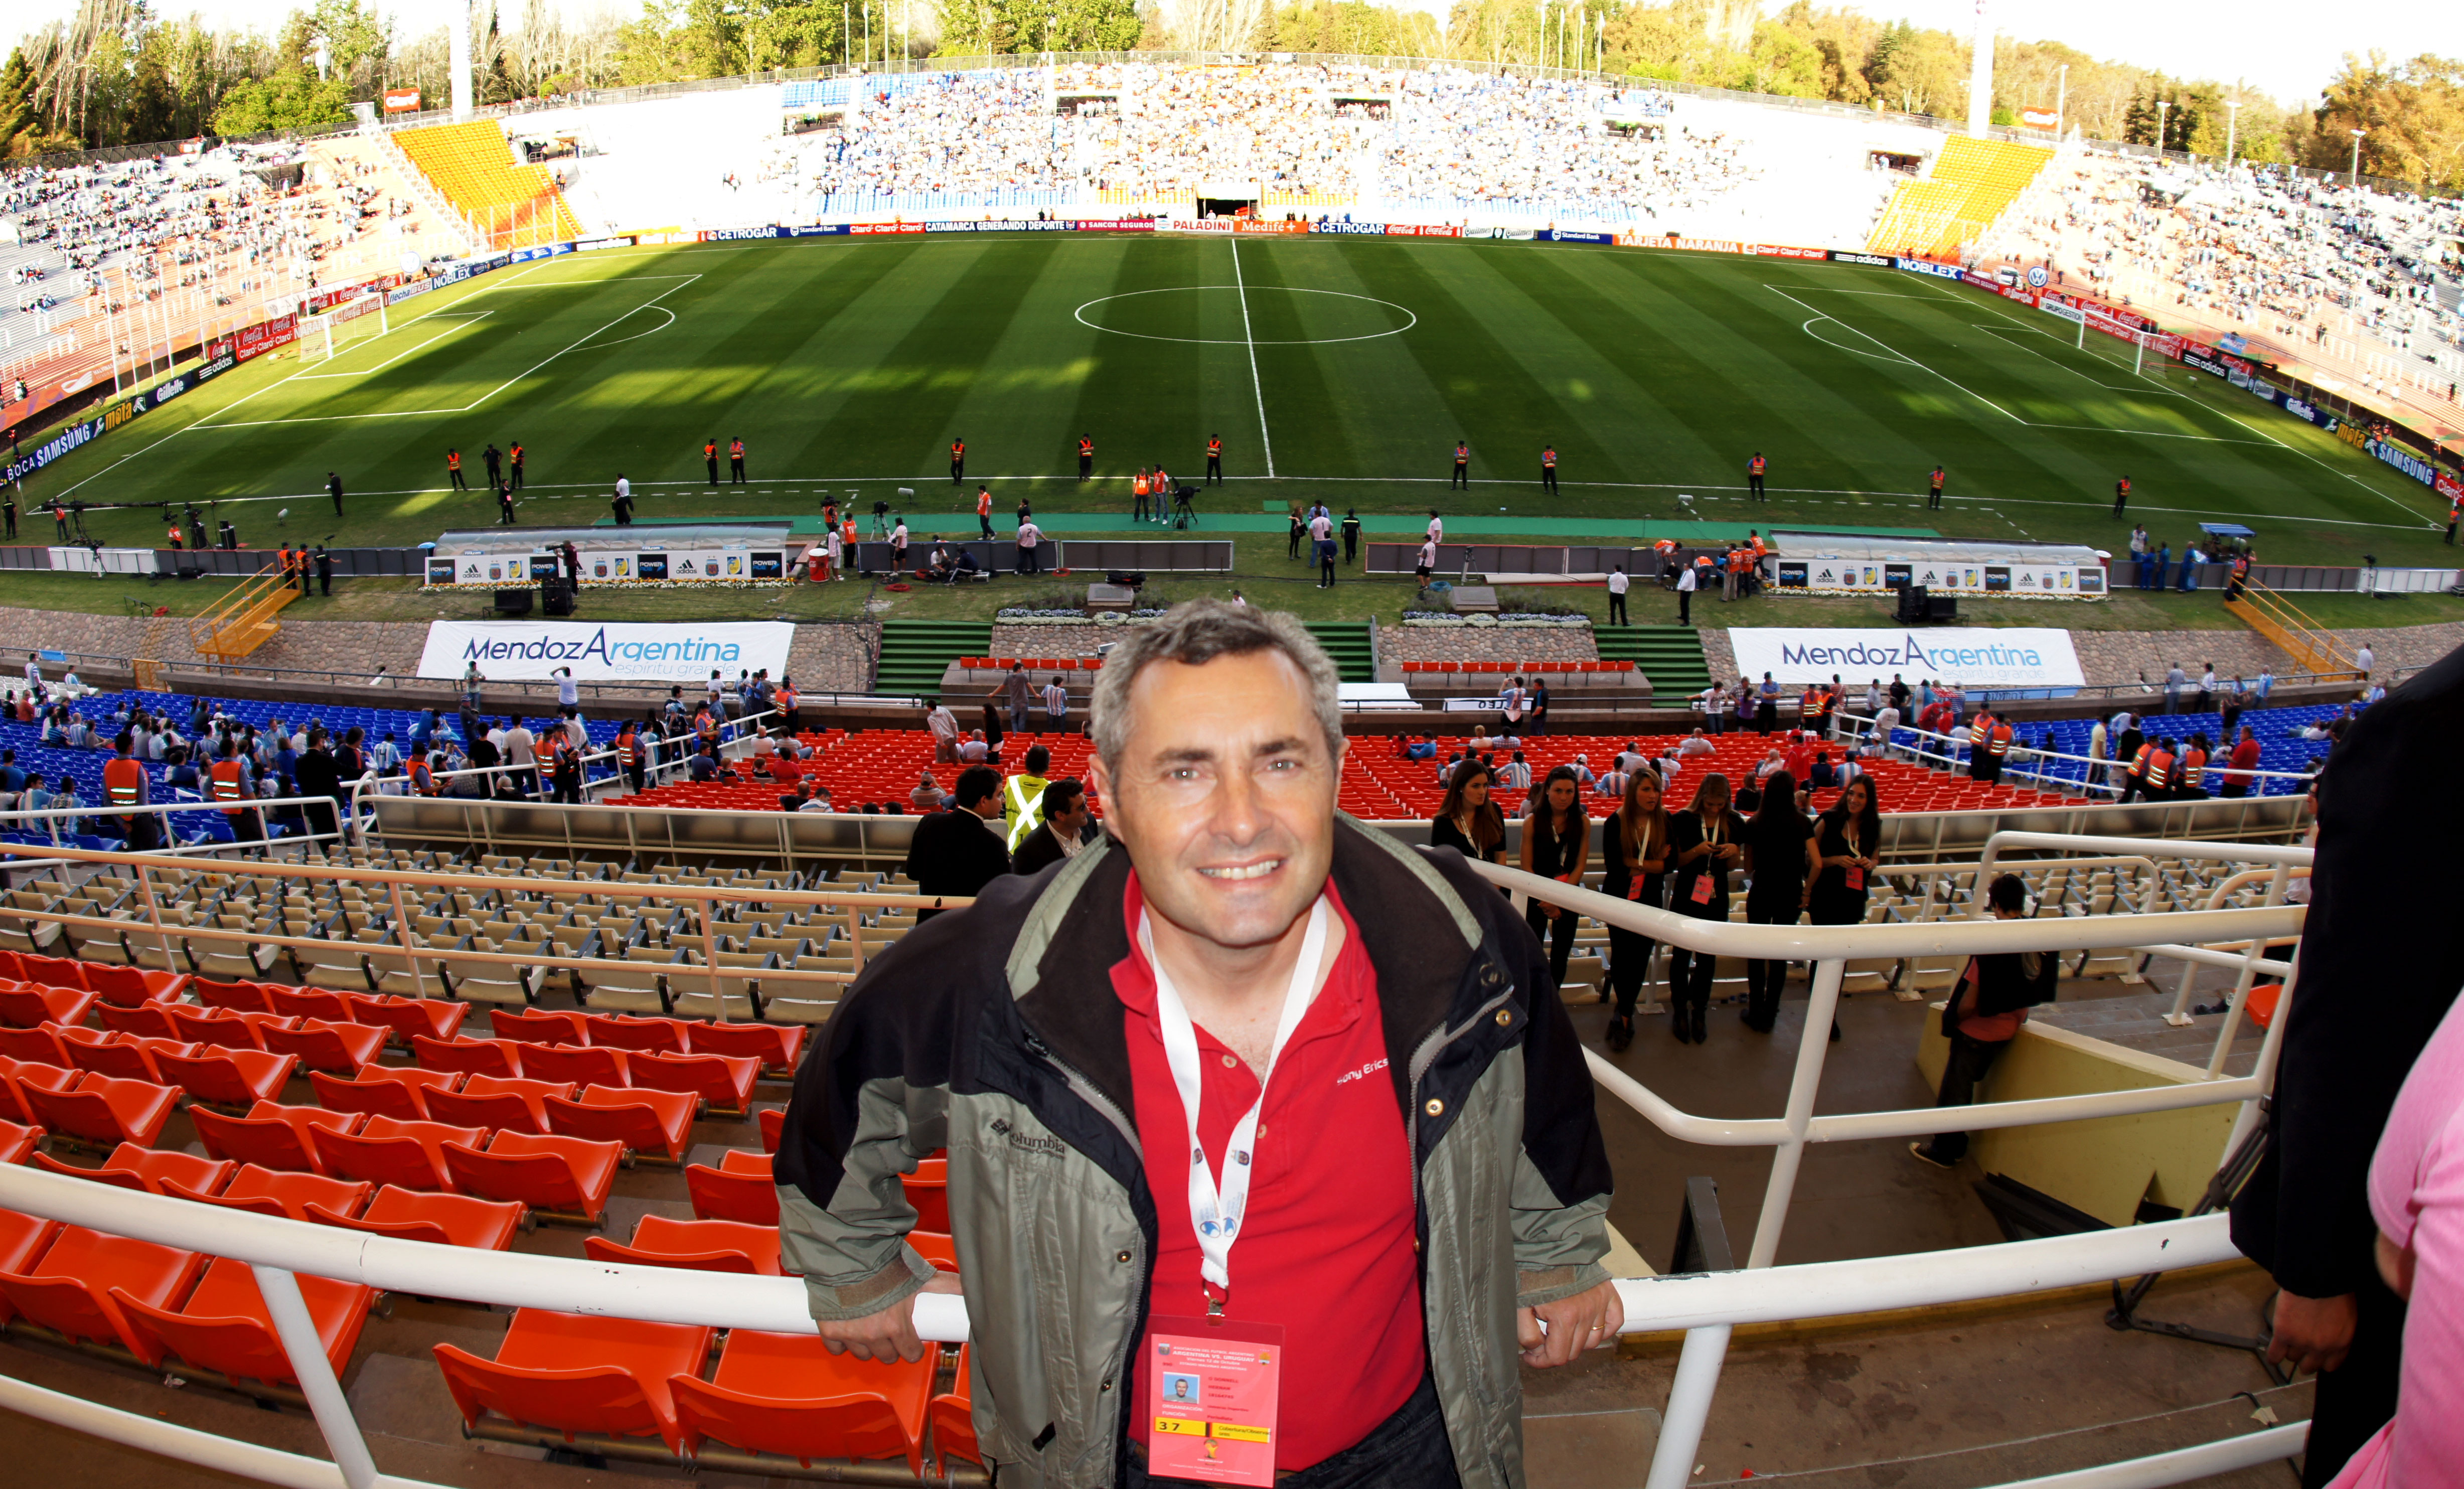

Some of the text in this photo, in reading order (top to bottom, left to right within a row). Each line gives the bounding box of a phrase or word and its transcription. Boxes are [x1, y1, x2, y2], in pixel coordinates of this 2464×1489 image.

[718, 227, 777, 240] CETROGAR
[850, 223, 923, 233] Claro Claro Claro
[926, 221, 1065, 232] CATAMARCA GENERANDO DEPORTE
[1173, 220, 1230, 230] PALADINI
[1242, 221, 1284, 231] Medifé
[1321, 223, 1385, 234] CETROGAR
[1388, 224, 1416, 234] Coca-Cola
[1425, 225, 1453, 235] Coca-Cola
[1465, 226, 1491, 235] Quilmes
[1505, 229, 1532, 238] Quilmes
[1618, 235, 1739, 252] TARJETA NARANJA
[1758, 246, 1825, 258] Claro Claro Claro
[1857, 255, 1889, 266] adidas
[1898, 258, 1958, 279] NOBLEX
[434, 267, 470, 288] NOBLEX
[1965, 274, 1999, 291] SANCOR SEGUROS
[340, 285, 362, 302] Coca-Cola
[389, 281, 431, 303] flecha BUS
[2046, 303, 2063, 315] GRUPO
[272, 315, 290, 334] Coca-Cola
[294, 317, 336, 339] NARANA
[243, 326, 263, 346] Coca-Cola
[239, 331, 292, 359] Claro Claro Claro
[212, 355, 233, 373] adidas
[2200, 360, 2225, 377] adidas
[157, 378, 184, 402] Gillette
[105, 402, 132, 431] mota
[2286, 398, 2315, 422] Gillette
[2337, 422, 2366, 449] mota
[37, 425, 90, 467] SAMSUNG
[7, 458, 36, 481] BOCA
[2379, 443, 2432, 485] SAMSUNG
[2437, 479, 2462, 500] Claro
[1026, 528, 1032, 538] 2
[1733, 555, 1741, 563] 34
[1744, 554, 1754, 563] 35
[461, 625, 740, 668] MendozArgentina
[1782, 633, 2042, 672] MendozArgentina
[615, 662, 735, 677] espíritu grande
[1998, 668, 2046, 681] grande
[375, 748, 387, 762] 14
[1008, 1123, 1065, 1154] Columbia
[1159, 1422, 1180, 1431] 3 7
